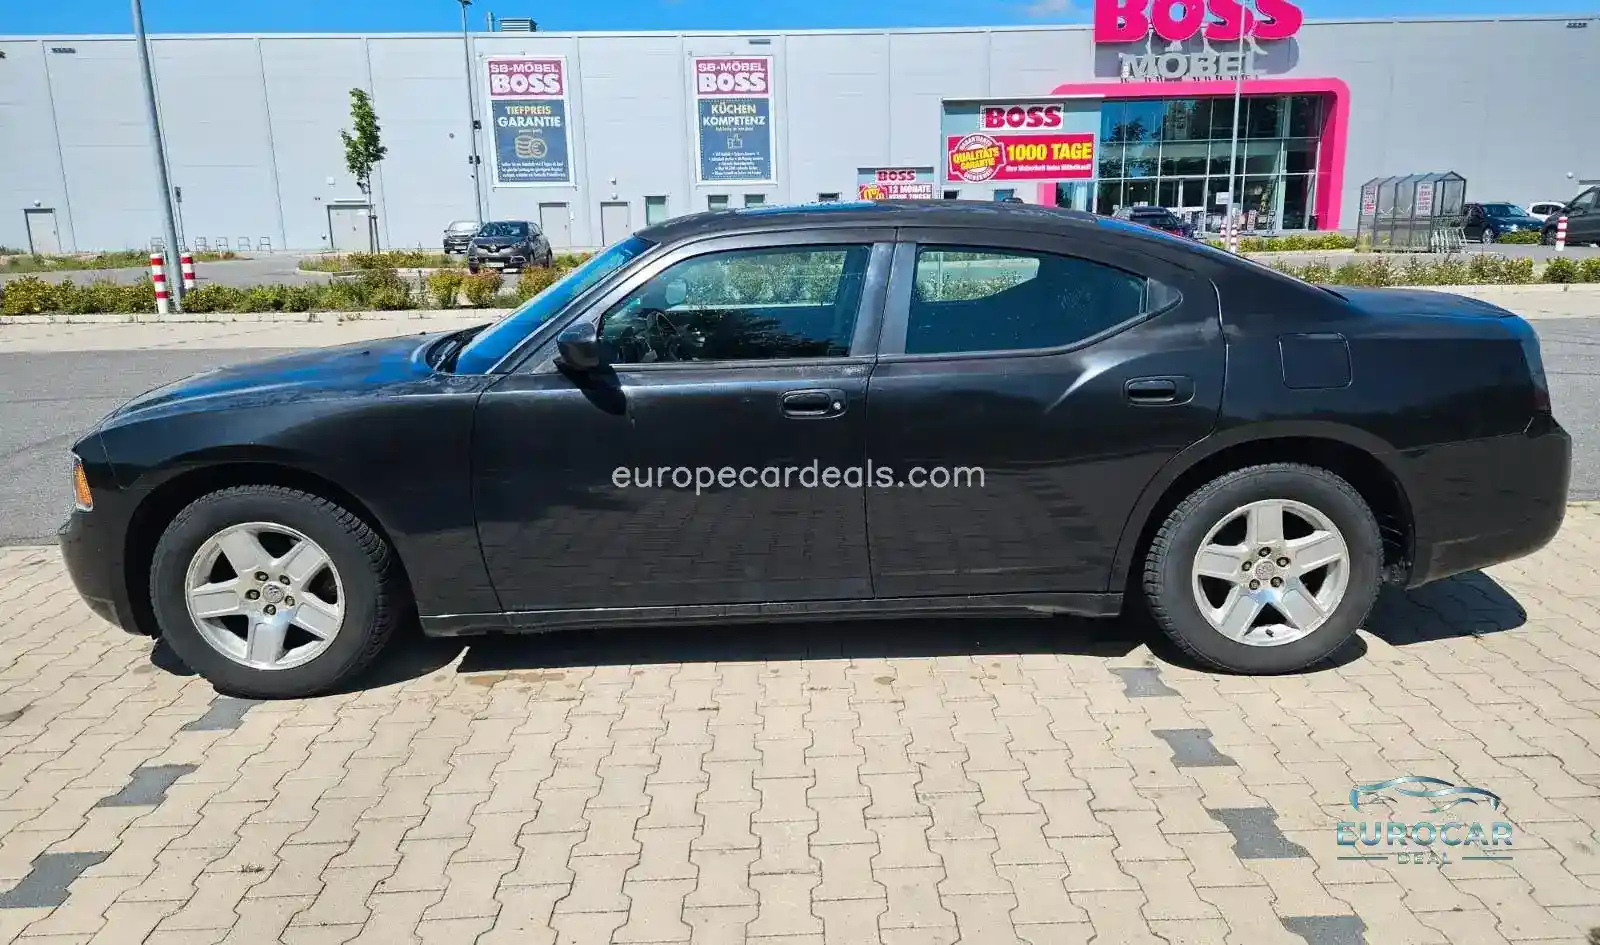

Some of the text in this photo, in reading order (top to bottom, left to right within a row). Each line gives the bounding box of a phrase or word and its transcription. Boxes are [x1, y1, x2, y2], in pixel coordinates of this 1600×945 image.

[1093, 0, 1303, 42] BOSS
[490, 61, 559, 73] SB-MÖBEL
[698, 60, 766, 72] SB-MÖBEL
[491, 73, 561, 94] BOSS
[698, 72, 767, 93] BOSS
[505, 105, 552, 115] TIEFPREIS
[711, 102, 757, 115] KÜCHEN
[498, 116, 561, 128] GARANTIE
[703, 115, 766, 126] KOMPETENZ
[985, 106, 1062, 129] BOSS
[1007, 142, 1092, 161] 1000 TAGE
[878, 170, 915, 181] BOSS
